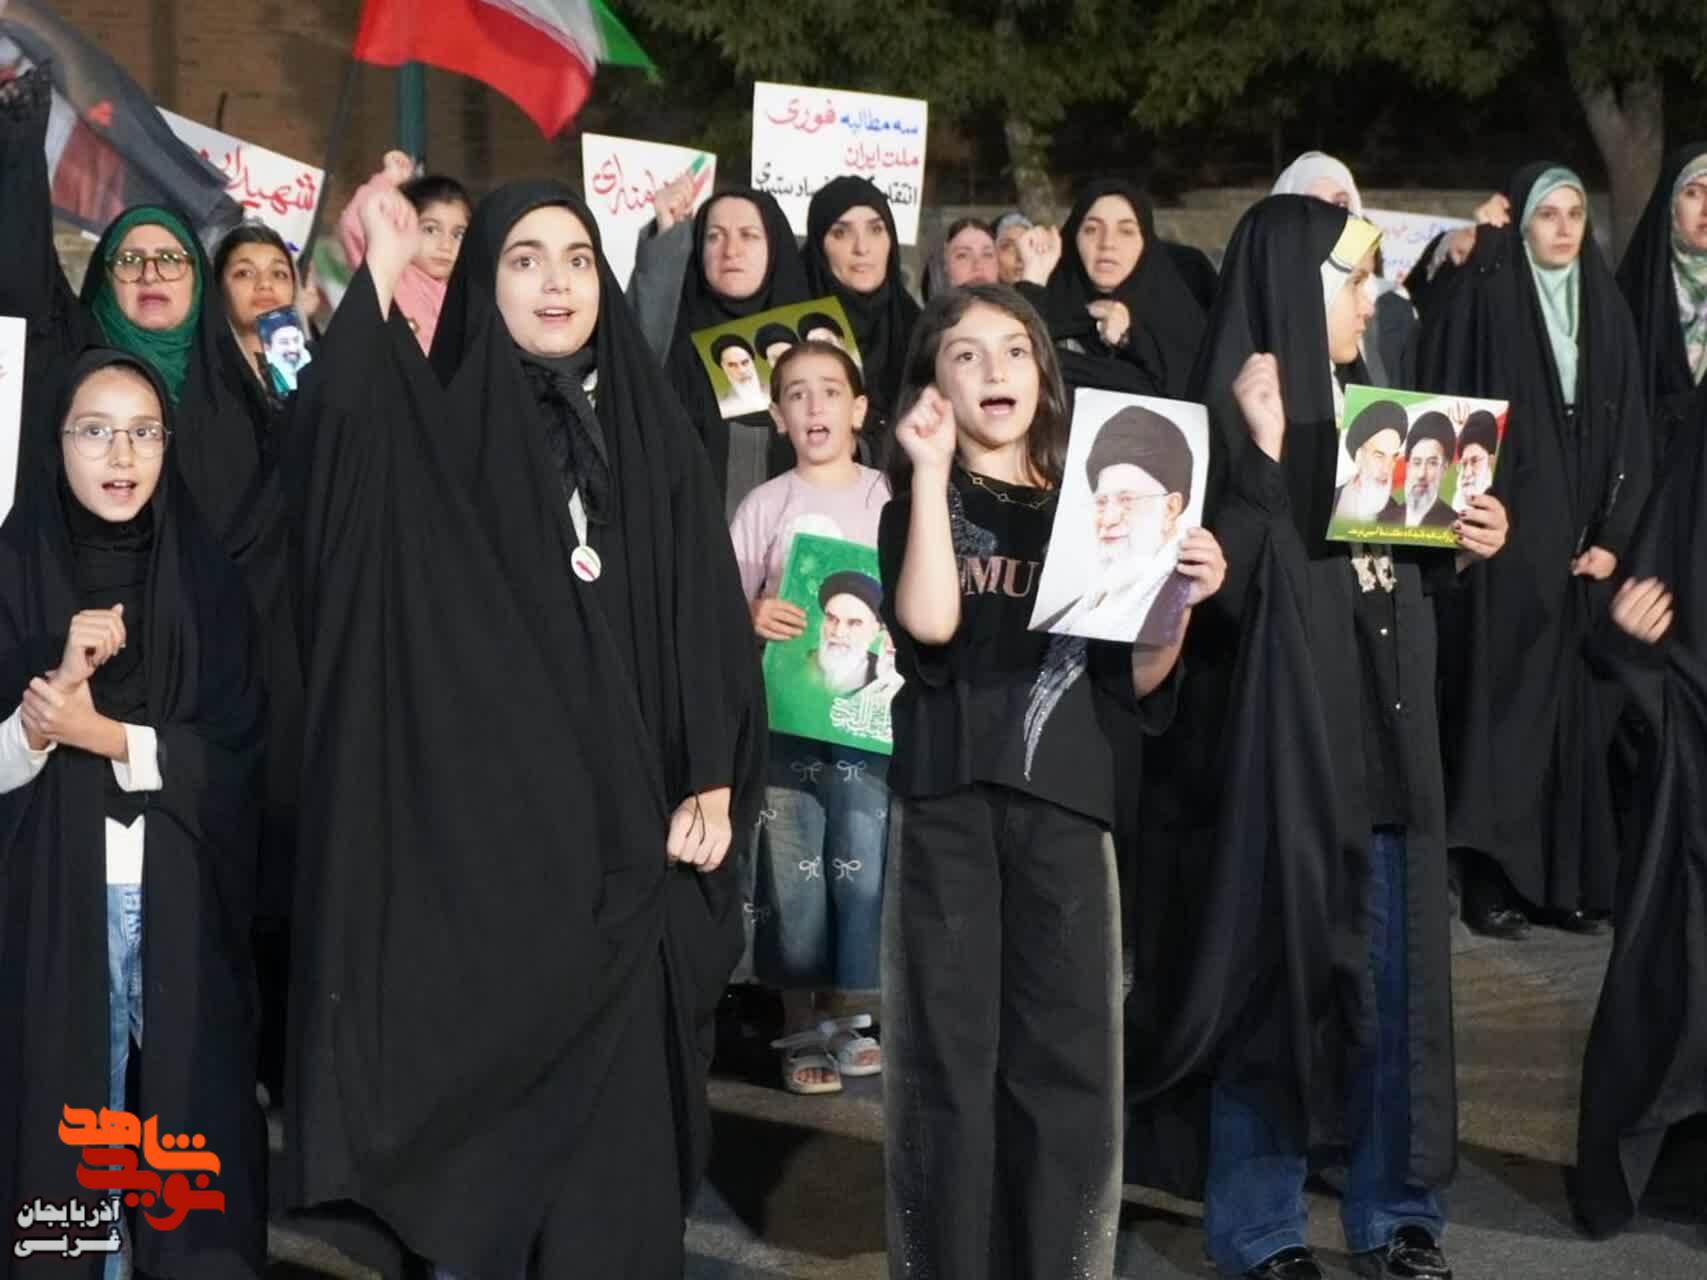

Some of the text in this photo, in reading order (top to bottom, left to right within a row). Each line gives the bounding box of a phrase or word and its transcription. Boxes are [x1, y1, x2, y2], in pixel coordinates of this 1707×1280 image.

[767, 98, 837, 134] فوری
[844, 143, 920, 170] ملت ایران
[887, 181, 918, 205] انتقا
[957, 555, 1041, 598] MU
